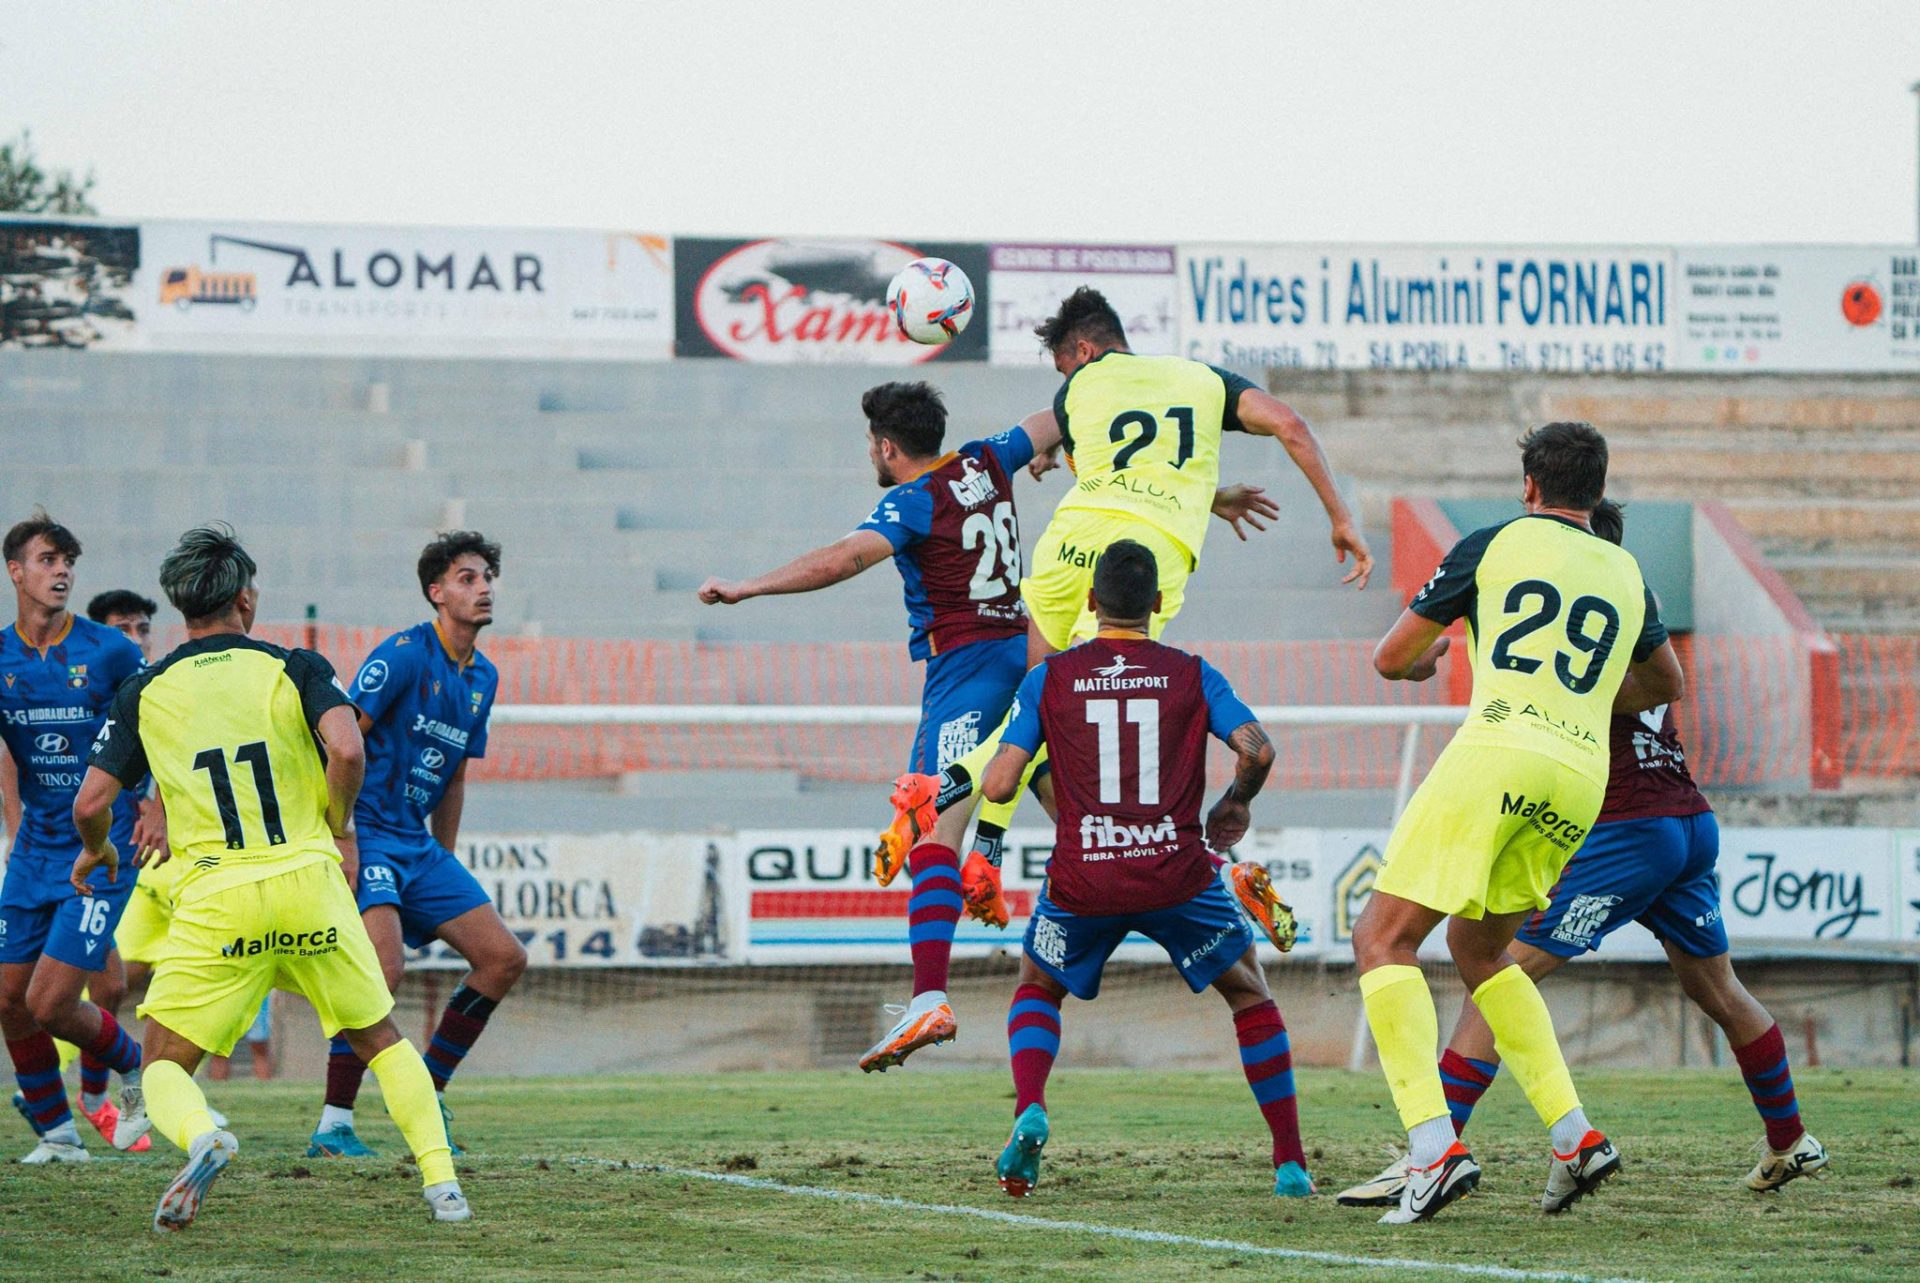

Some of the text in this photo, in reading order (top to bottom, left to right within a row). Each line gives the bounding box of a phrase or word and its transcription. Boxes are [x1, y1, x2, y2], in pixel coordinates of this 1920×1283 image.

[286, 249, 543, 292] ALOMAR
[1188, 258, 1306, 324] Vidres
[1319, 258, 1330, 324] i
[1345, 257, 1484, 324] Alumini
[1496, 259, 1665, 325] FORNARI
[729, 283, 908, 343] Xam
[1109, 407, 1195, 473] 21
[1057, 543, 1101, 568] Mal
[1491, 579, 1620, 695] 29
[28, 706, 84, 721] HIDRAULICA
[1520, 704, 1600, 750] ALUA
[31, 755, 79, 764] HYUNDAI
[1086, 699, 1160, 804] 11
[193, 741, 287, 850] 11
[1079, 815, 1177, 849] fibwi
[1501, 792, 1584, 843] Mallorca
[460, 843, 549, 871] IONS
[1083, 844, 1179, 862] FIBRA MÓVIL TV
[79, 897, 110, 936] 16
[1733, 853, 1879, 938] Jony
[222, 927, 337, 957] Mallorca
[1191, 921, 1236, 961] FULLANA
